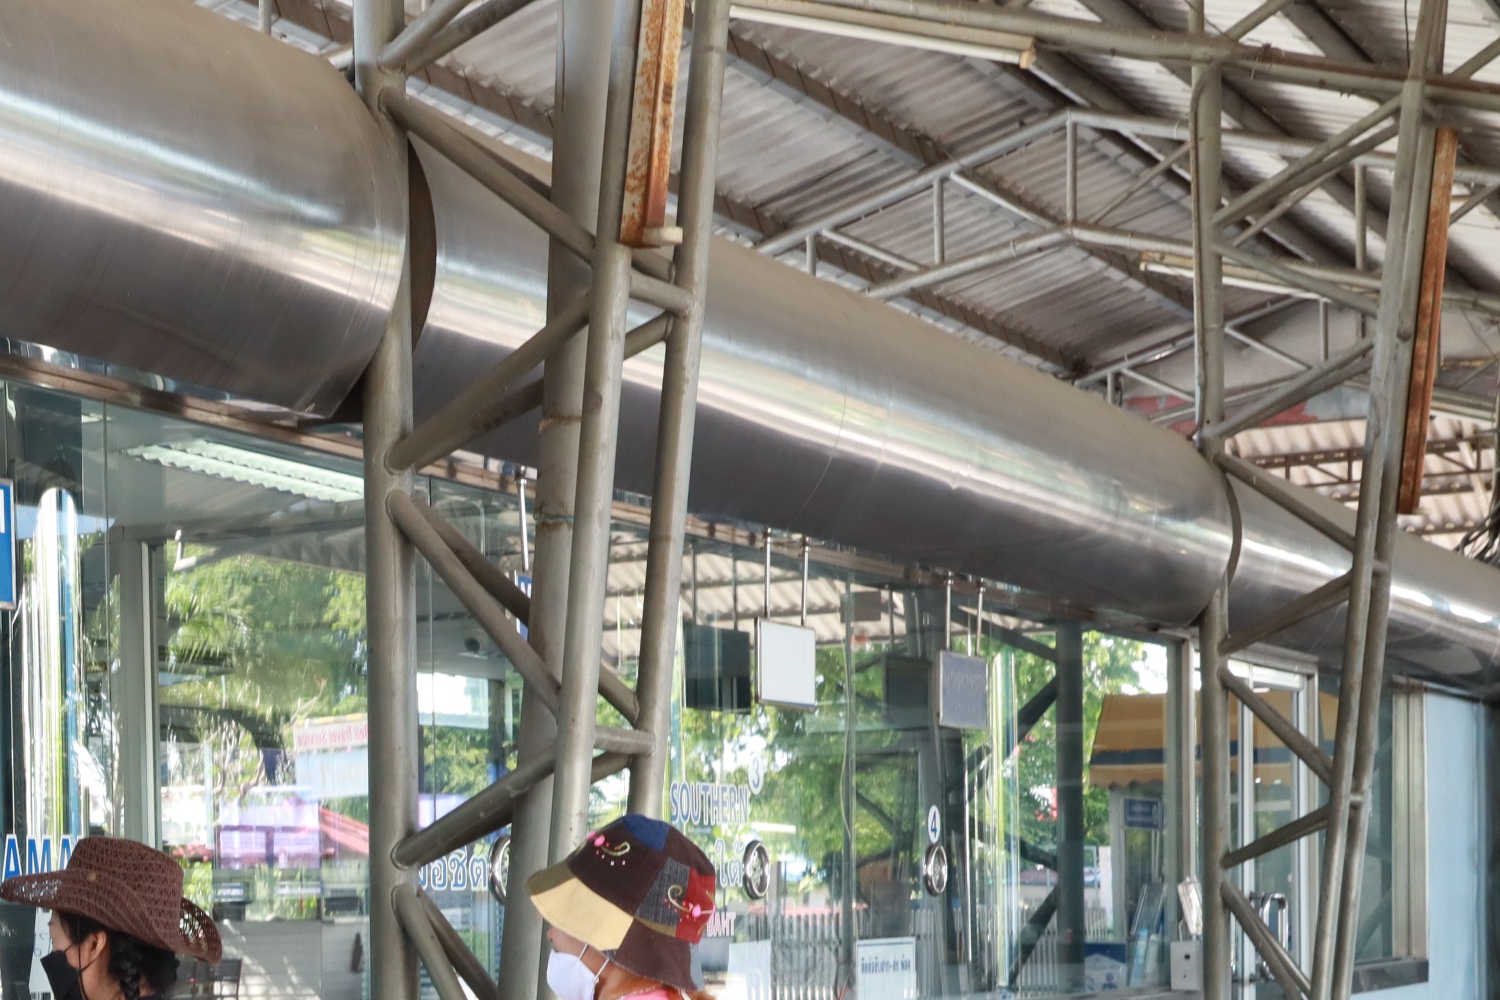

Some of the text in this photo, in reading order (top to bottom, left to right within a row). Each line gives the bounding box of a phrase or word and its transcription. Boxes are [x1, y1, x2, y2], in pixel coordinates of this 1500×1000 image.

[751, 757, 760, 789] 3
[670, 780, 750, 826] SOUTHERN
[930, 810, 938, 839] 4
